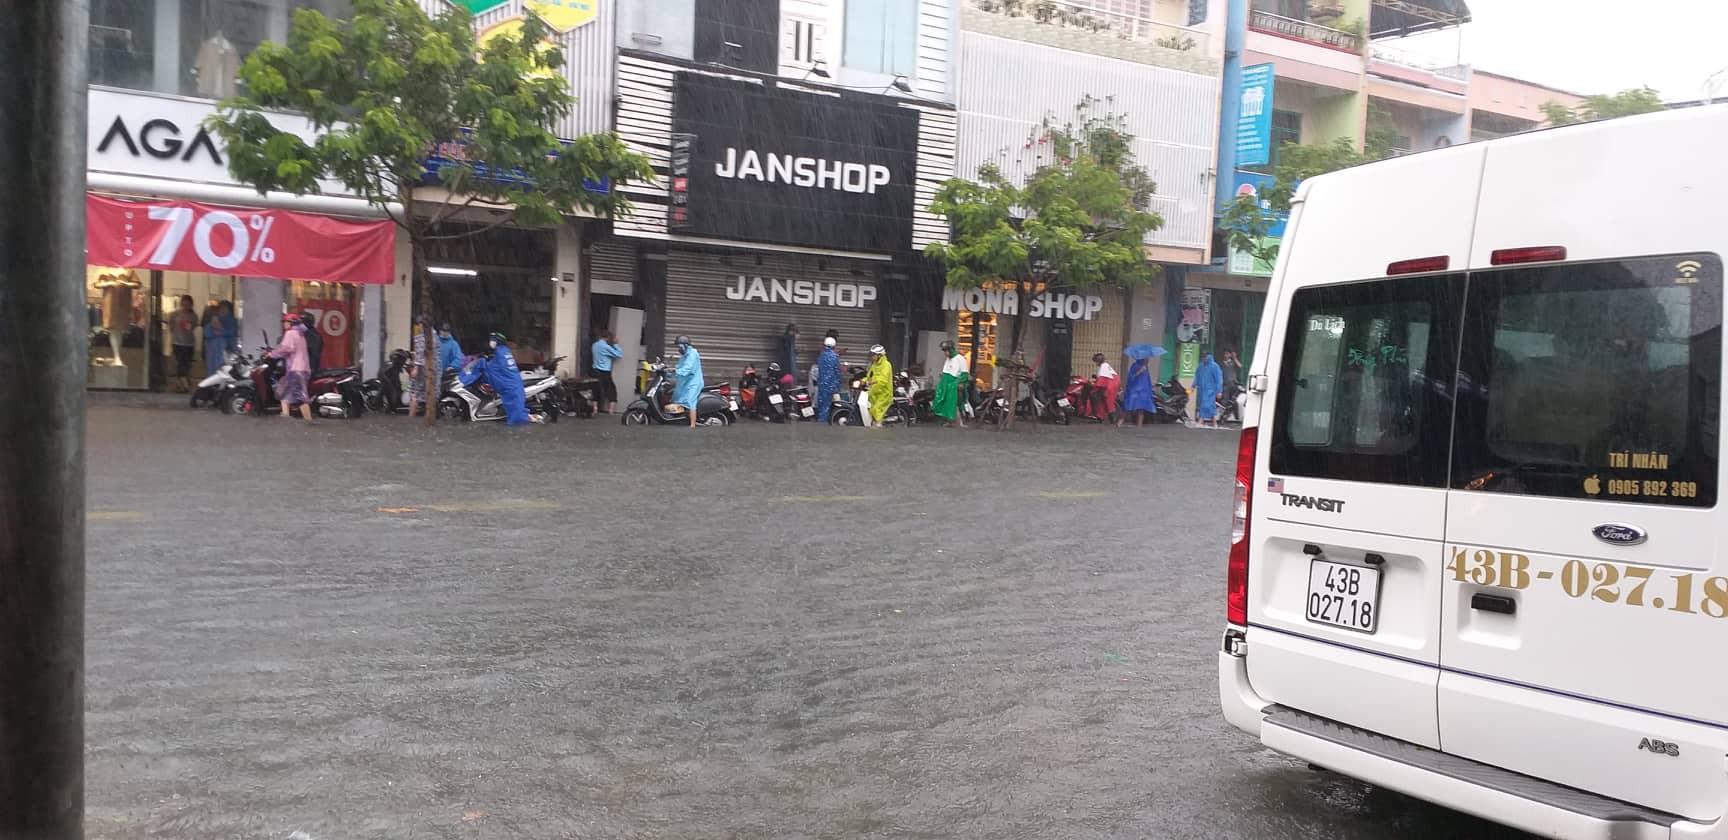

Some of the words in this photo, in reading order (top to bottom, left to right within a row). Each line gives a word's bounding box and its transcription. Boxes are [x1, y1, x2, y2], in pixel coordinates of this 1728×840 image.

[97, 115, 224, 165] AGA
[715, 147, 891, 194] JANSHOP
[147, 205, 275, 269] 70%
[726, 275, 877, 308] JANSHOP
[941, 286, 1019, 316] MONA
[1028, 292, 1104, 321] SHOP
[1609, 450, 1629, 468] TRÍ
[1631, 451, 1668, 470] NHÂN
[1280, 492, 1346, 513] TRANSIT
[1608, 479, 1639, 495] 0905
[1643, 480, 1668, 497] 892
[1671, 481, 1697, 498] 369
[1600, 526, 1633, 540] Ford
[1325, 565, 1361, 596] 43B
[1309, 592, 1372, 628] 027.18
[1638, 737, 1680, 757] ABS
